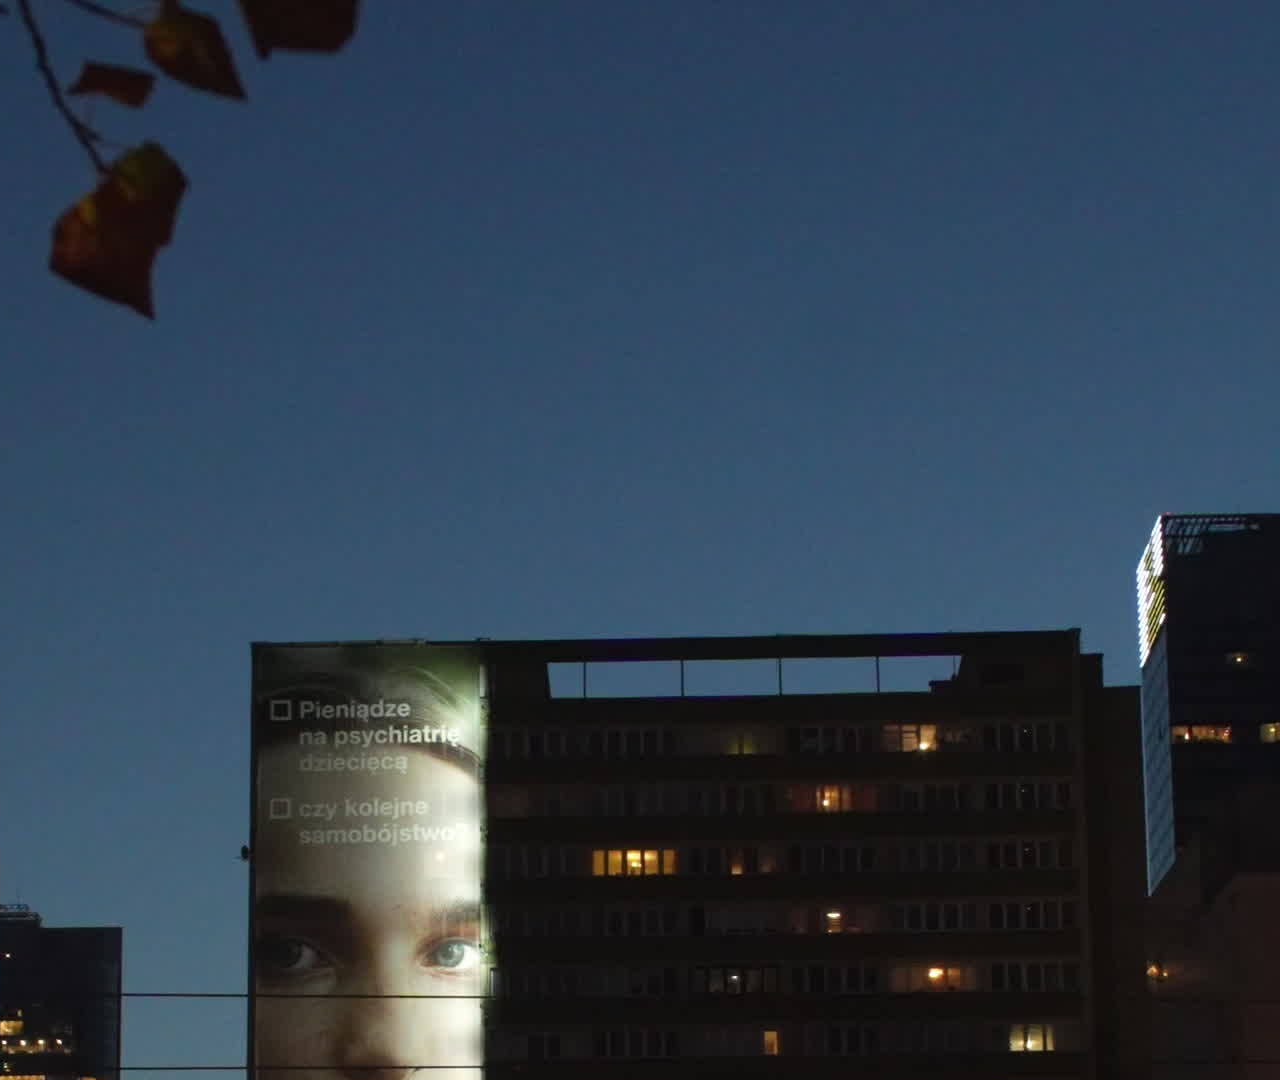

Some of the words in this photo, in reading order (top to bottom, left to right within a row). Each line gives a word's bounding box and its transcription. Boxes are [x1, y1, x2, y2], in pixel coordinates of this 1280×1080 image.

[299, 699, 411, 722] Pieniądze
[299, 731, 327, 745] na
[335, 724, 460, 747] psychiatrię
[299, 803, 337, 820] czy
[345, 799, 429, 820] kolejne
